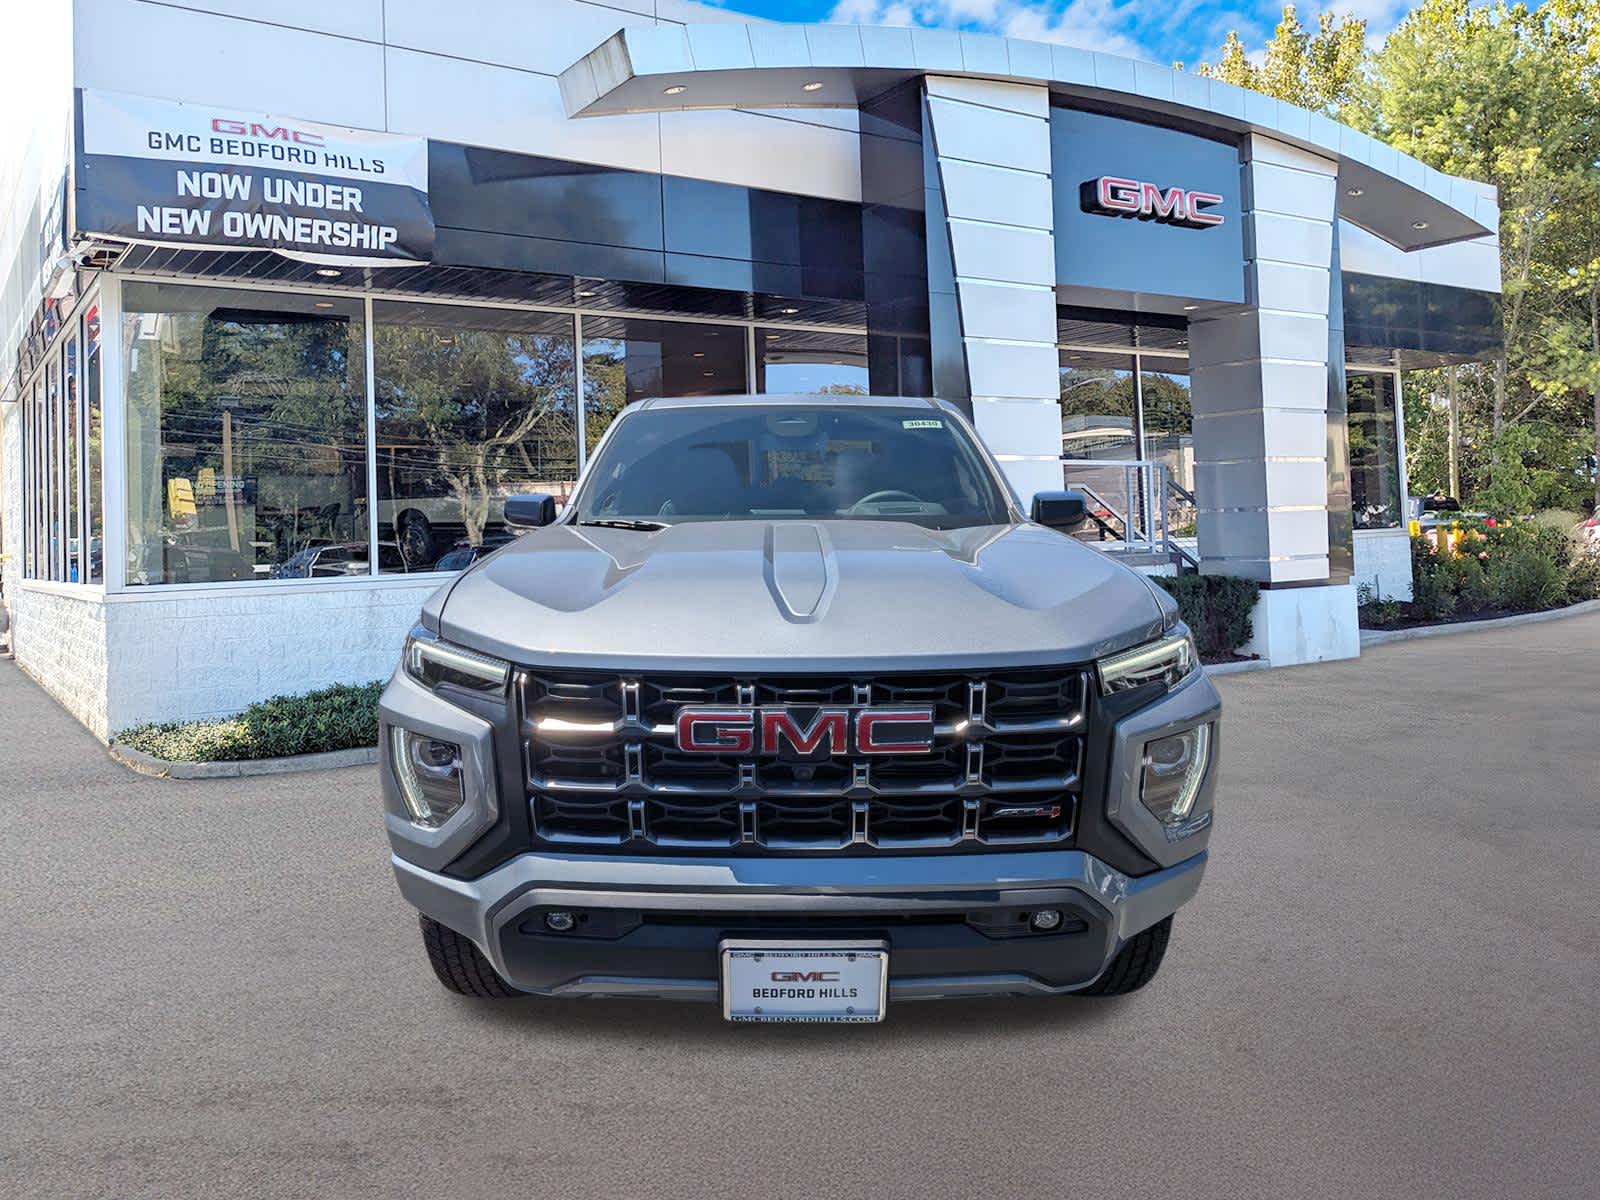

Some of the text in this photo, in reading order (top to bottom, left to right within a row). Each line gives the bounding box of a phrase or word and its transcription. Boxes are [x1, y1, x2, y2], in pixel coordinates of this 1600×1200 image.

[148, 131, 385, 174] GMC BEDFORD HILLS
[211, 118, 326, 148] GMC
[177, 171, 364, 212] NOW UNDER
[1097, 176, 1225, 224] GMC
[137, 205, 398, 250] NEW OWNERSHIP
[677, 706, 934, 754] GMC
[752, 988, 857, 999] BEDFORD HILLS
[770, 971, 840, 982] GMC
